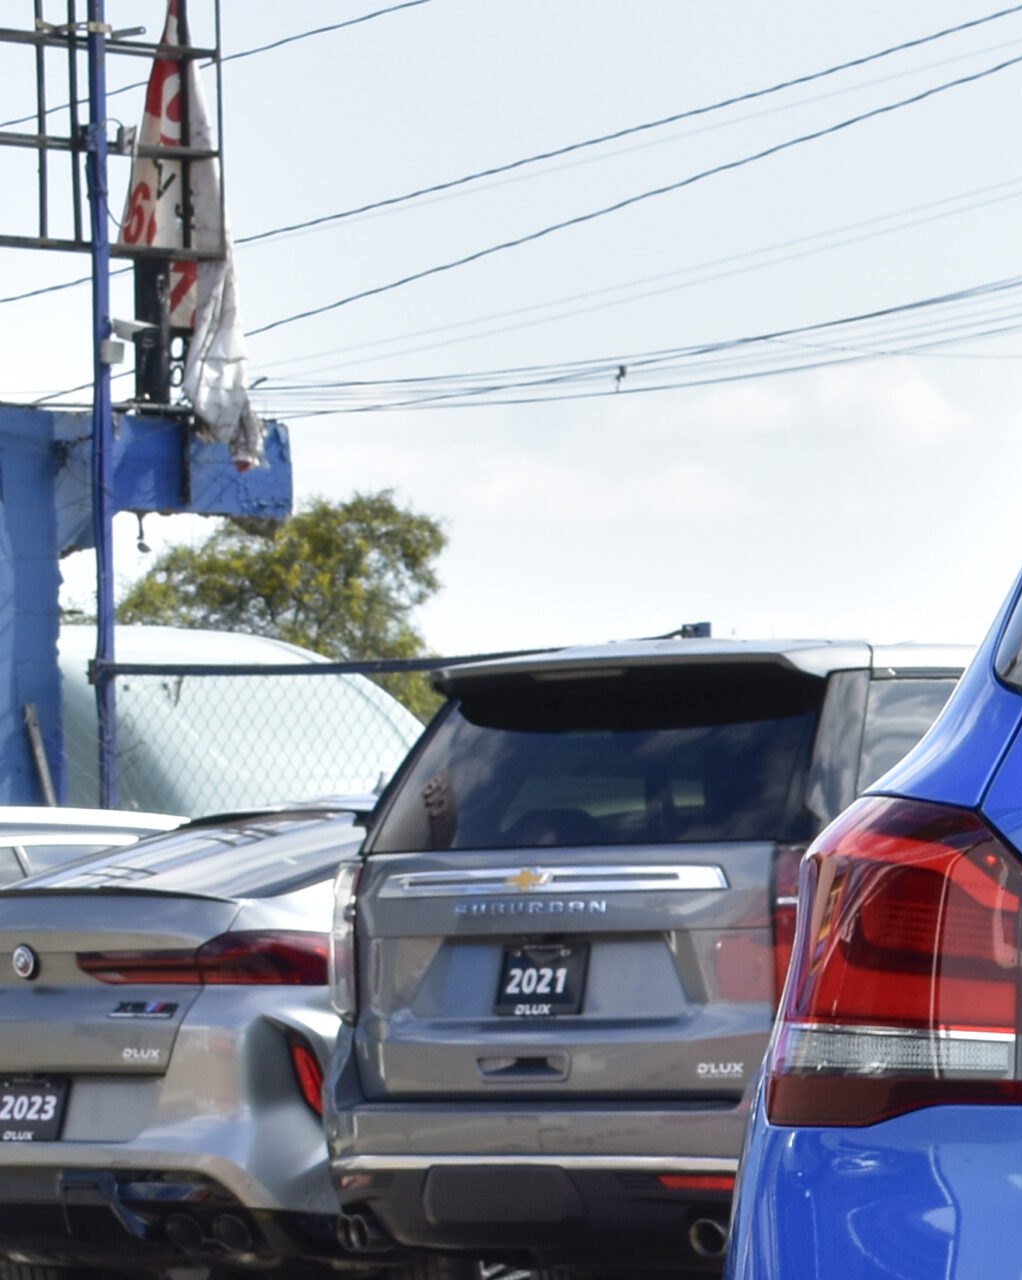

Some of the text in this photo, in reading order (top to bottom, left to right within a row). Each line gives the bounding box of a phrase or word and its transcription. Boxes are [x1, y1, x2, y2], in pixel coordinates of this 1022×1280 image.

[455, 900, 608, 915] SUBURBAN
[506, 967, 568, 995] 2021
[0, 1095, 58, 1121] 2023
